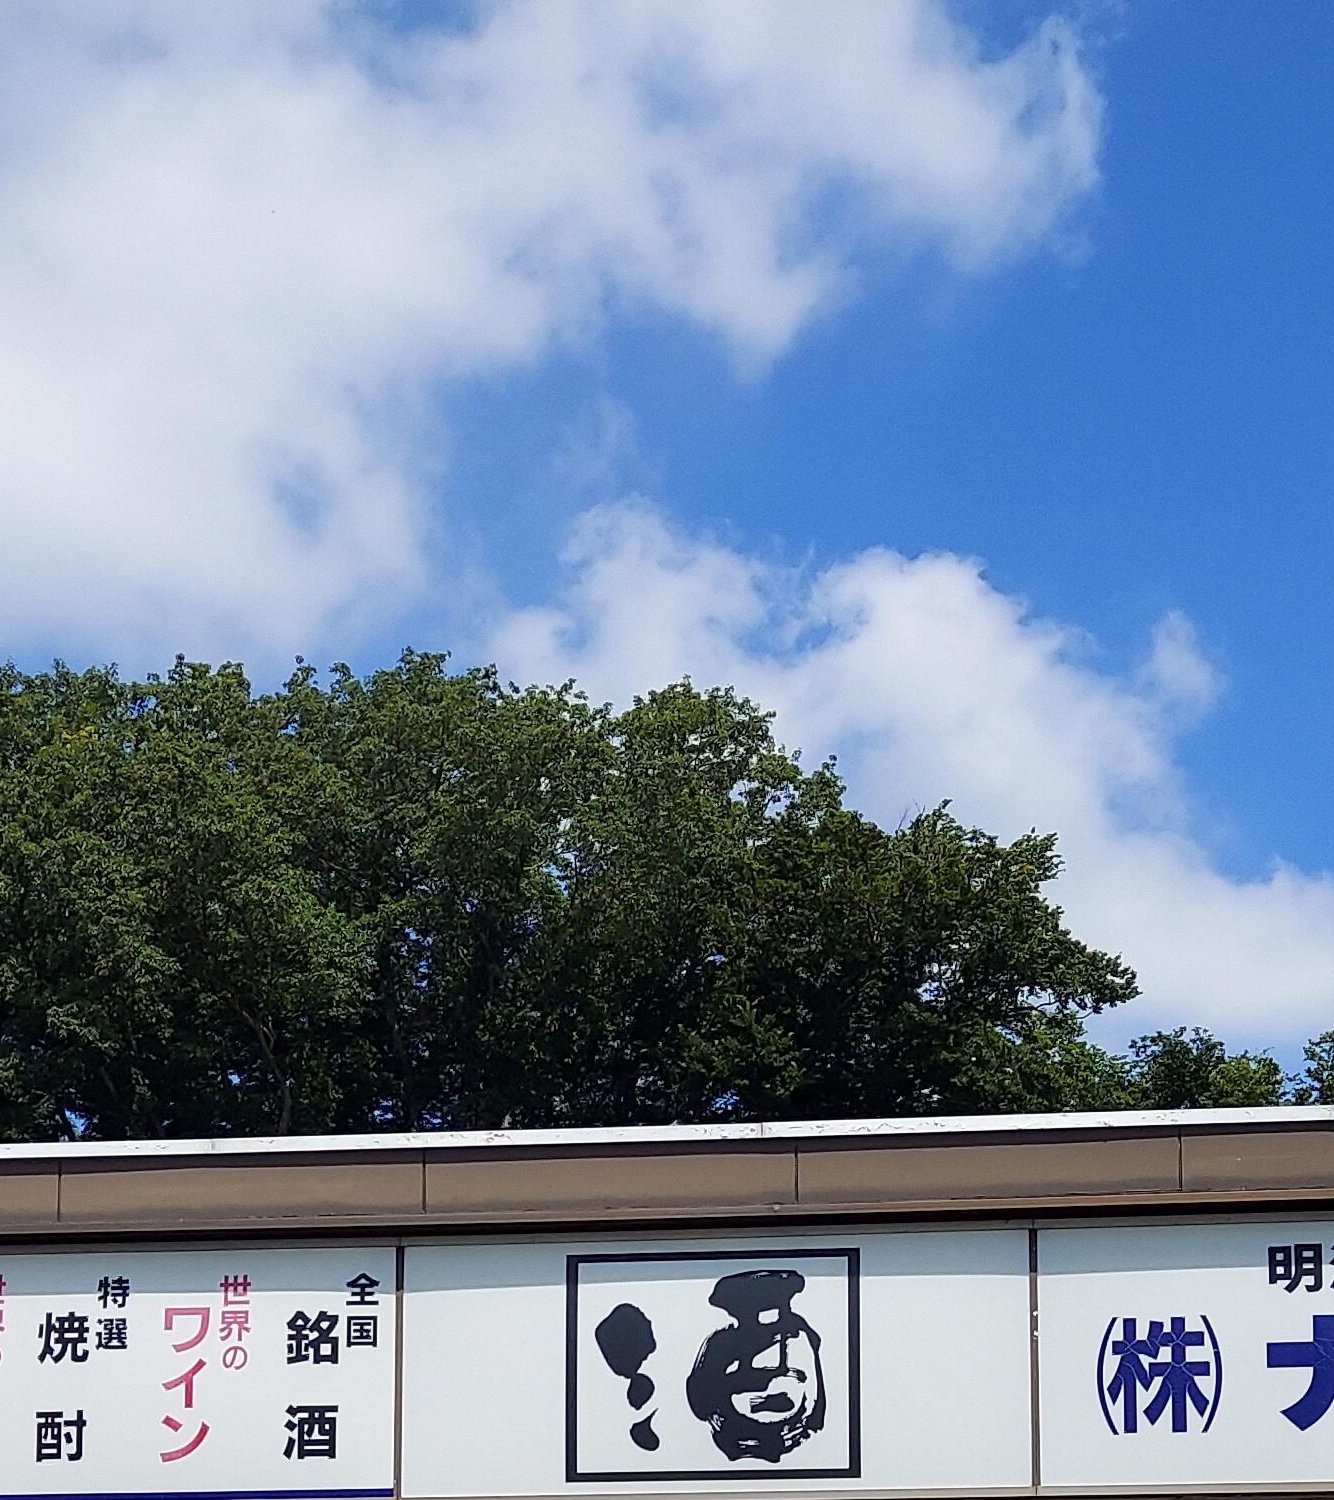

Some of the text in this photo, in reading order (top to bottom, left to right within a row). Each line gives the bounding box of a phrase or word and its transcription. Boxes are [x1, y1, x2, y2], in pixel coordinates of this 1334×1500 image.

[34, 1310, 90, 1462] 焼酎
[96, 1275, 130, 1351] 特選
[159, 1306, 211, 1462] ワイン
[219, 1273, 251, 1370] 世界の
[283, 1310, 340, 1461] 銘酒
[345, 1273, 380, 1348] 全国
[593, 1267, 828, 1464] 酒
